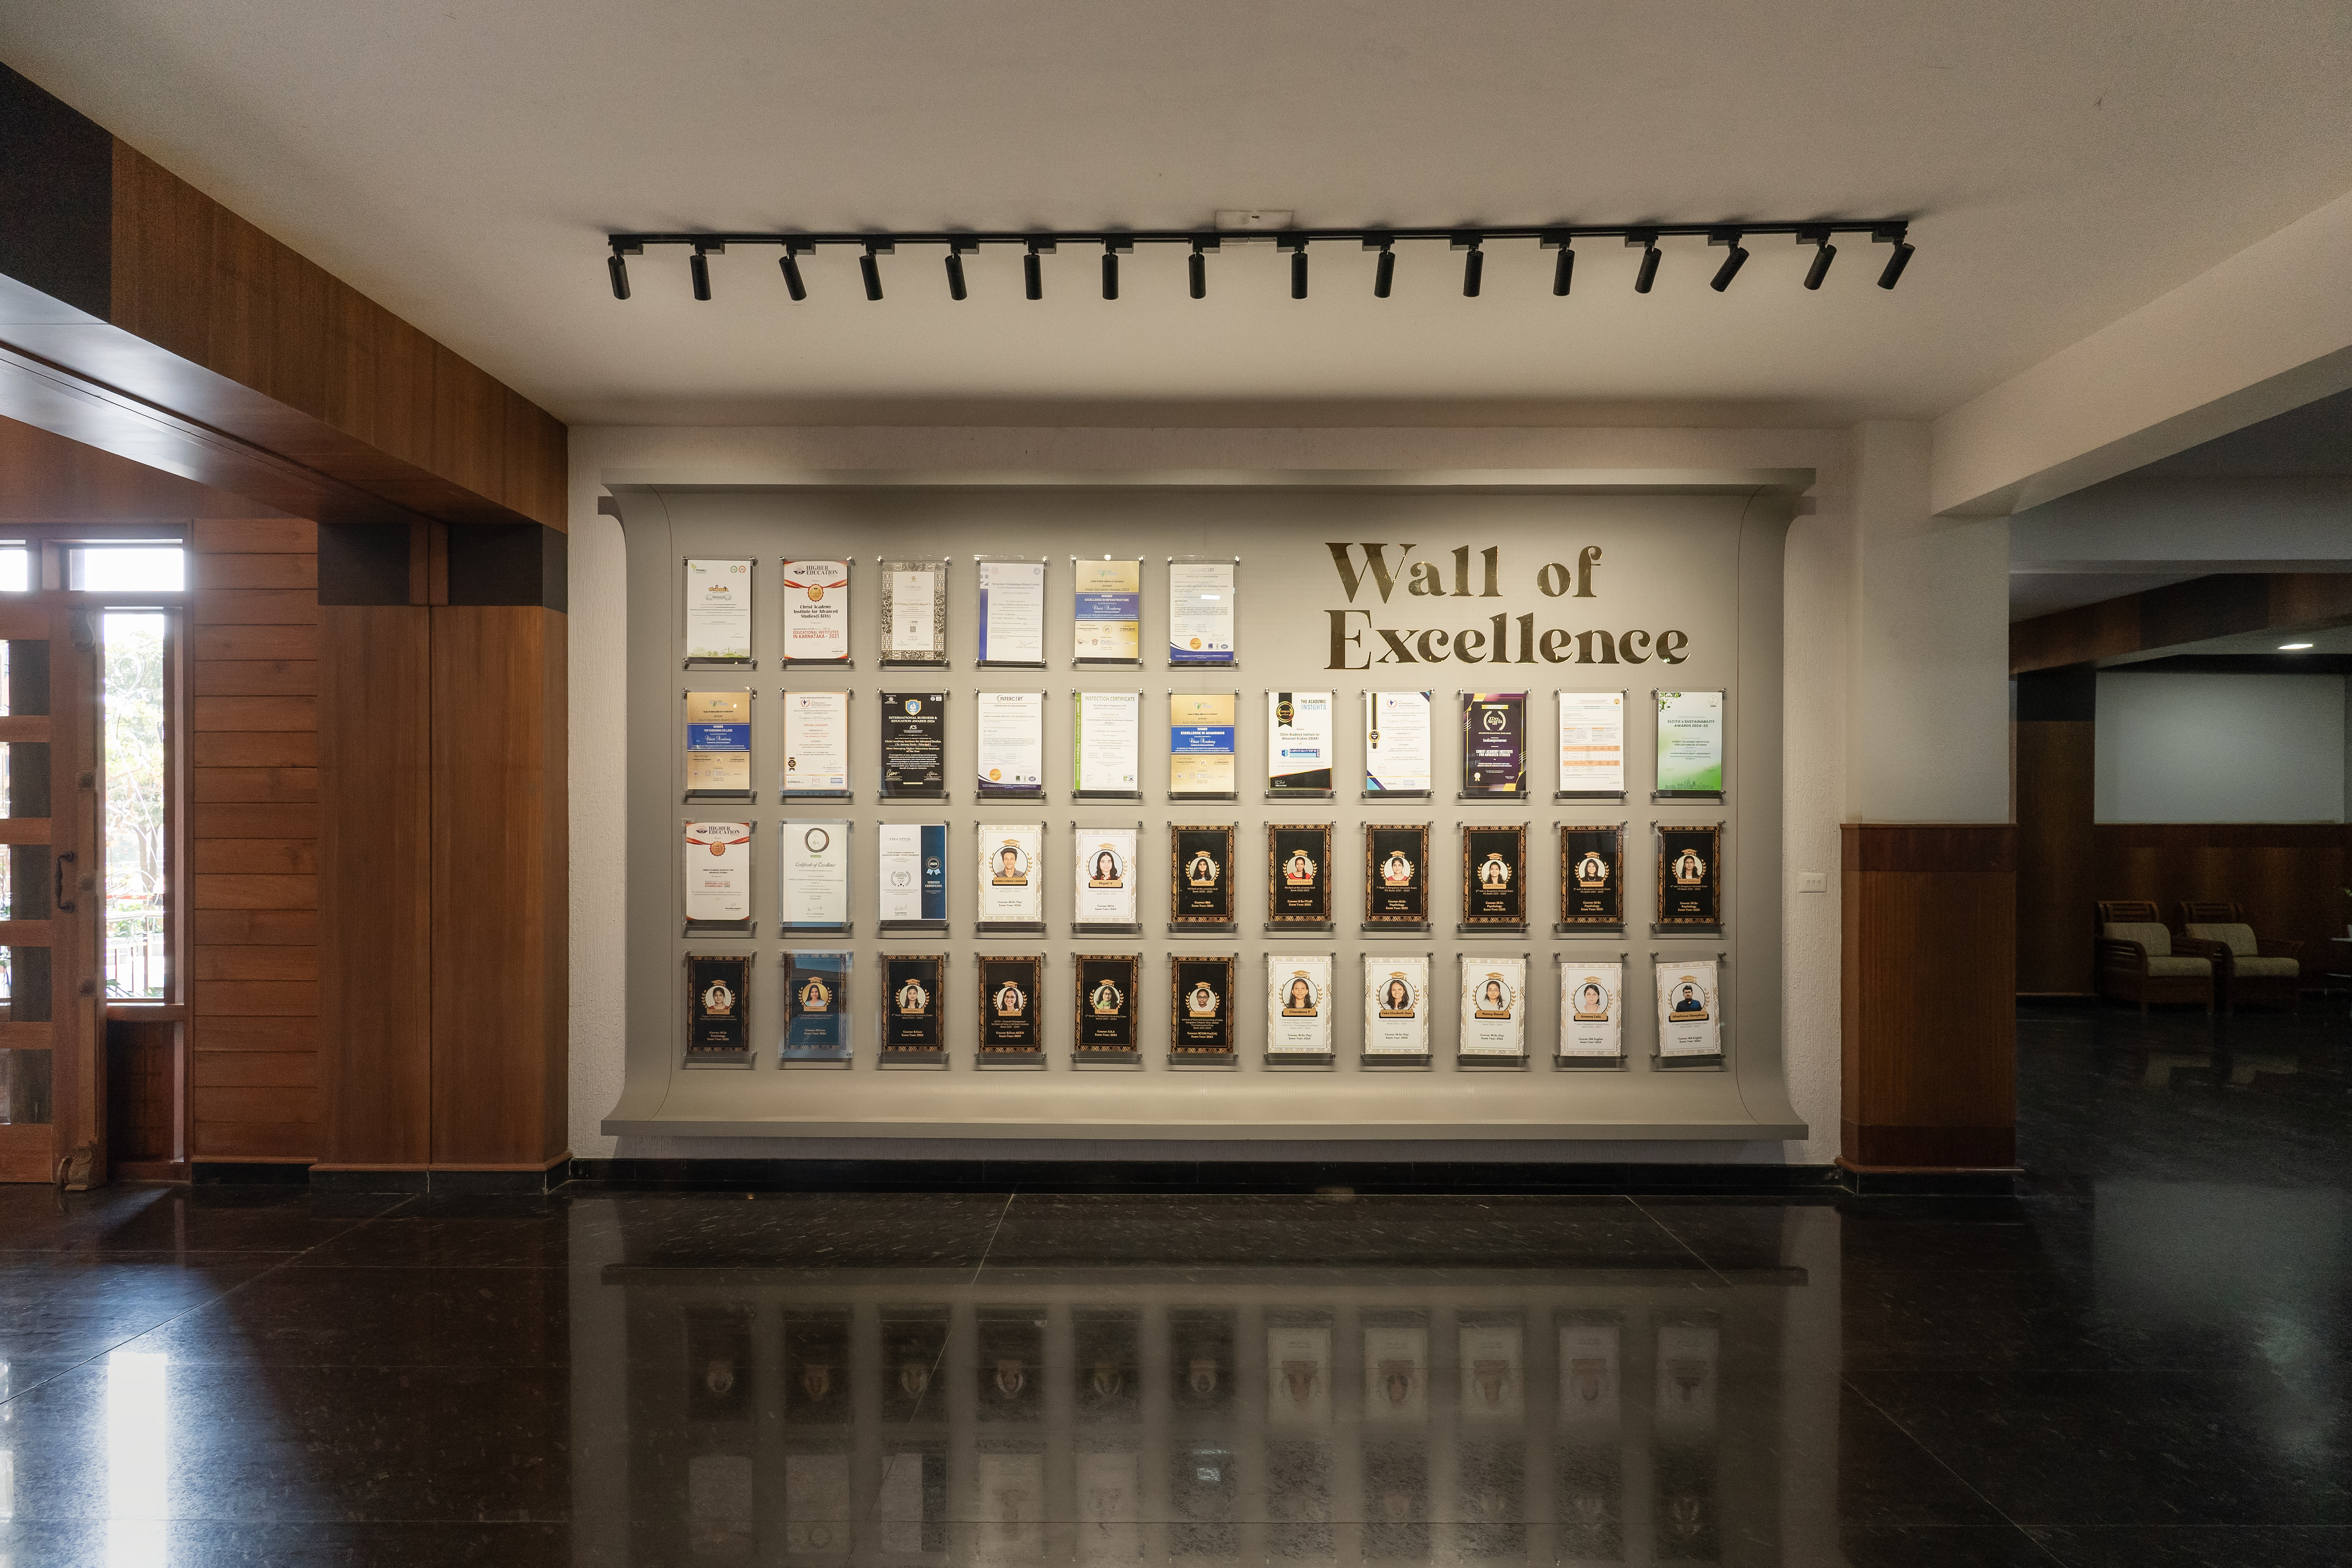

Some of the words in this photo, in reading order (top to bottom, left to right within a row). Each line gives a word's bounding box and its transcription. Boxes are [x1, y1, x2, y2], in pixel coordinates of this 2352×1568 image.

[1325, 543, 1503, 604] Wall
[1537, 546, 1602, 598] of
[1324, 610, 1691, 670] Excellence
